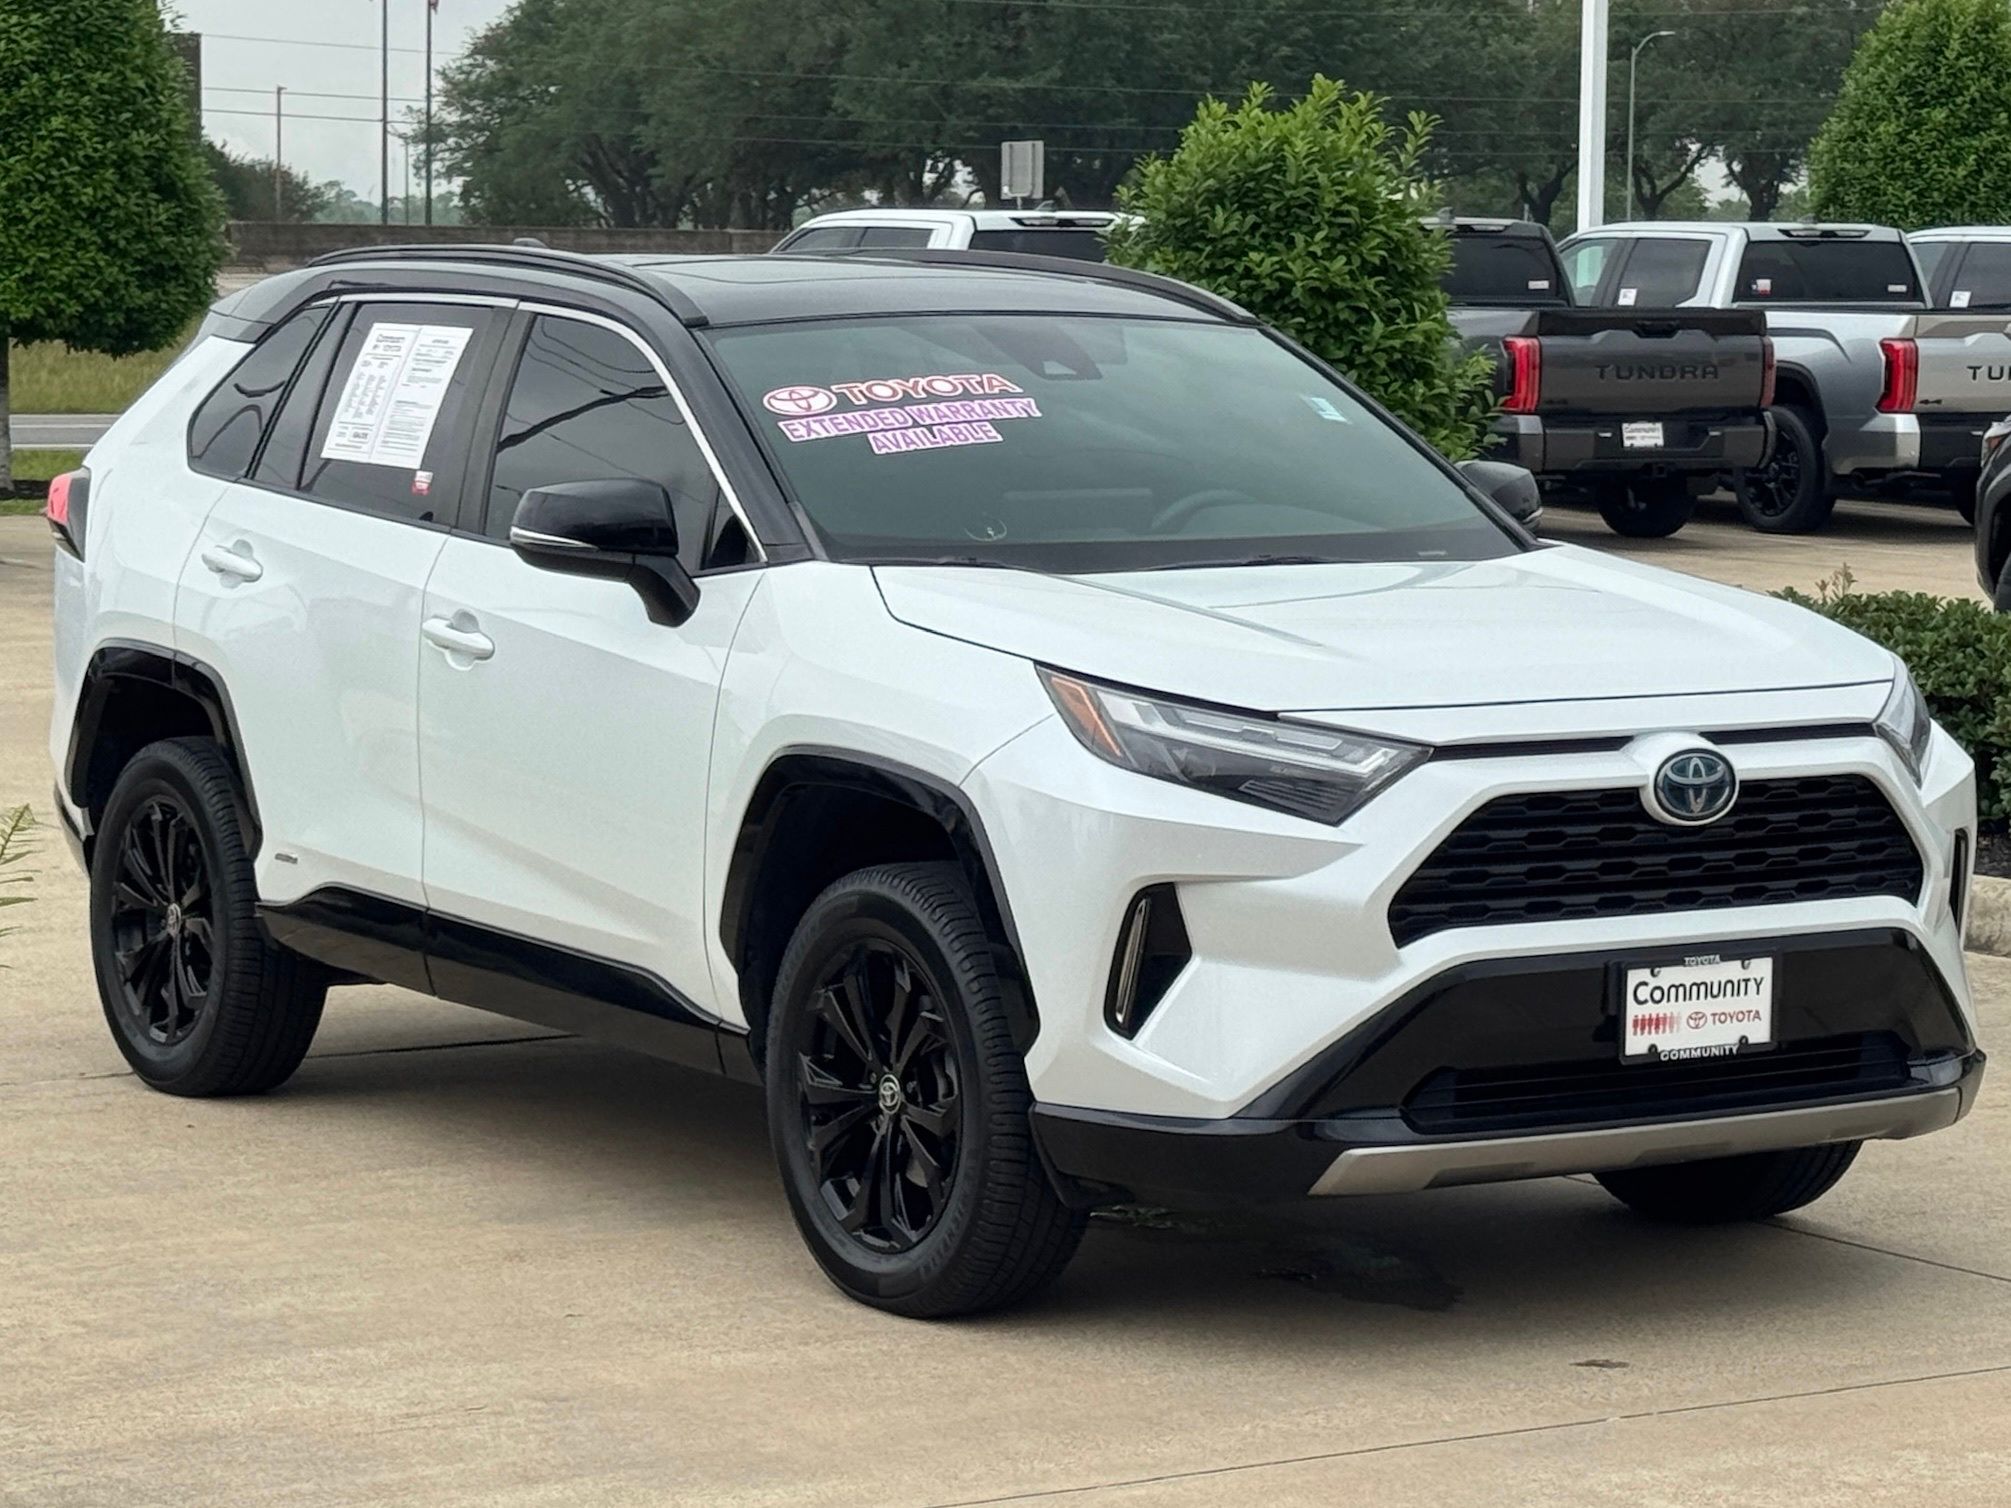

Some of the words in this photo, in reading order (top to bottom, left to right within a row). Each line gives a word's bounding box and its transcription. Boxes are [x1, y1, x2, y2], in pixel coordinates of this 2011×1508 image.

[1595, 364, 1719, 381] TUNDRA
[1966, 365, 2011, 381] TU
[832, 374, 1022, 404] TOYOTA
[783, 409, 910, 440] EXTENDED
[909, 400, 1039, 424] WARRANTY
[871, 422, 1001, 452] AVAILABLE
[1684, 954, 1721, 967] TOYOTA
[1711, 1010, 1762, 1025] TOYOTA
[1660, 1044, 1739, 1061] COMMUNITY
